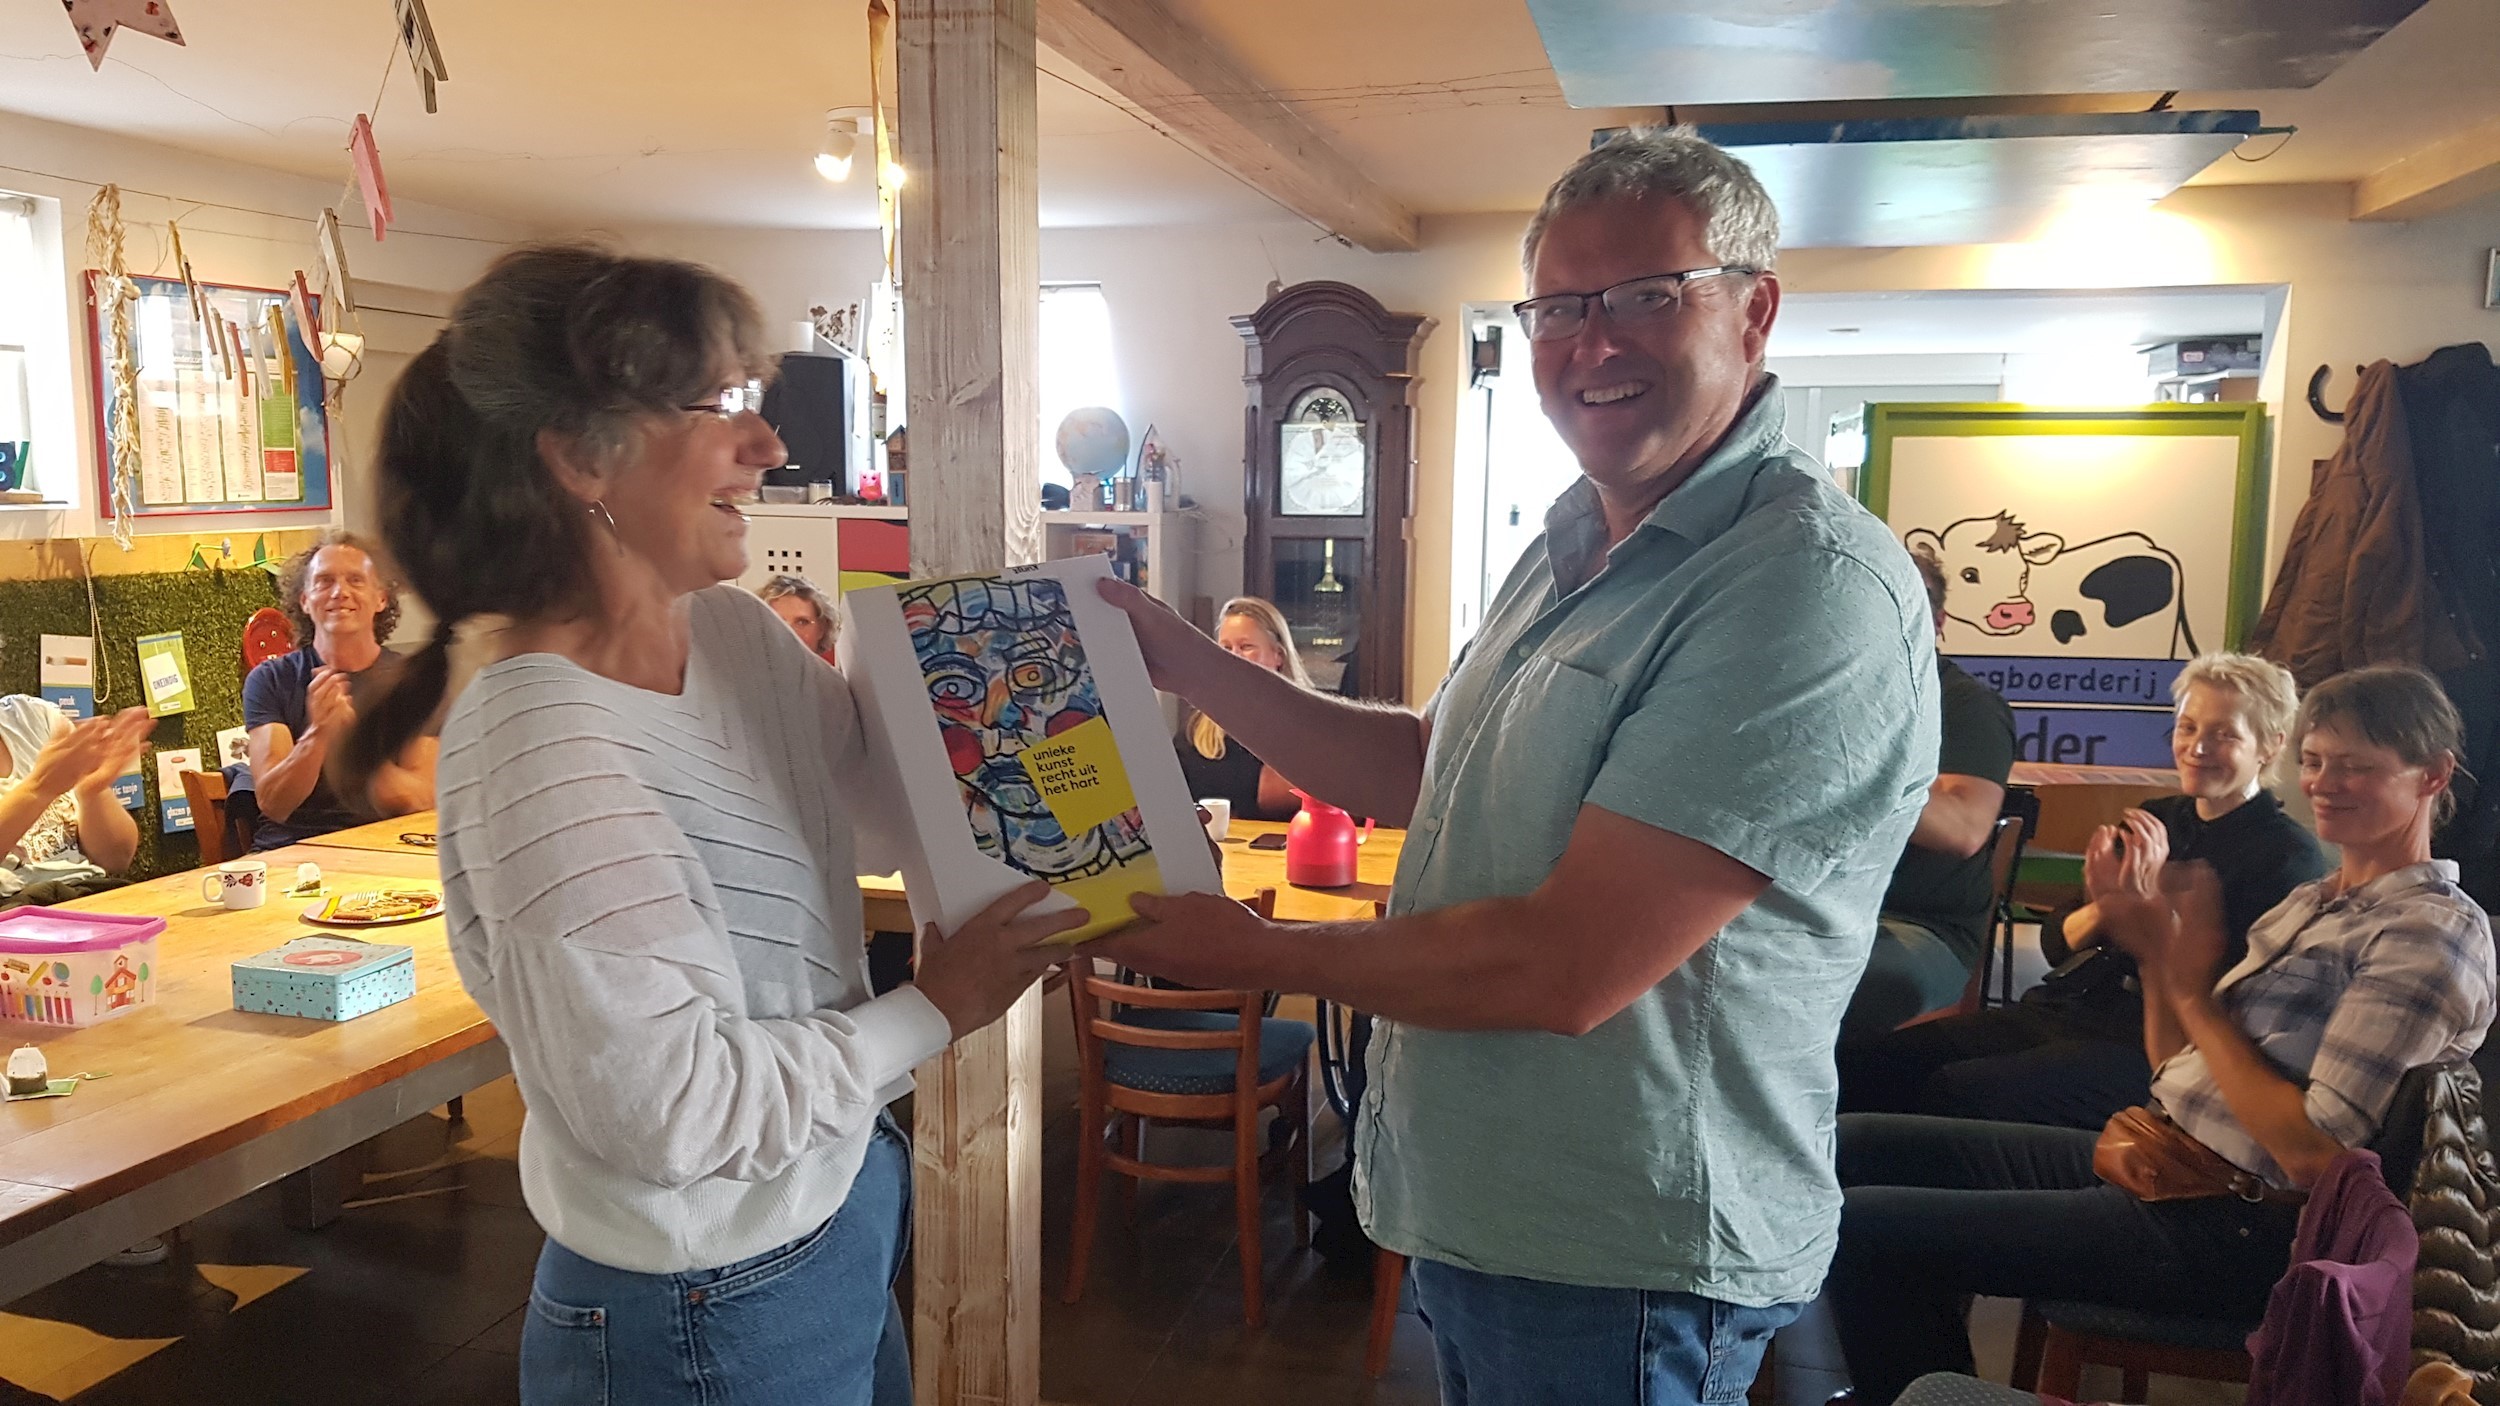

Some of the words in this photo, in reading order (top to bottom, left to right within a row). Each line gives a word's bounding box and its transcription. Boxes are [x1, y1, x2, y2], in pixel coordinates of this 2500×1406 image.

[2016, 716, 2107, 764] der
[1033, 744, 1076, 761] unieke
[1036, 757, 1075, 772] kunst
[1040, 769, 1077, 785] recht
[1079, 764, 1098, 776] uit
[1044, 781, 1068, 796] het
[1070, 776, 1100, 791] hart
